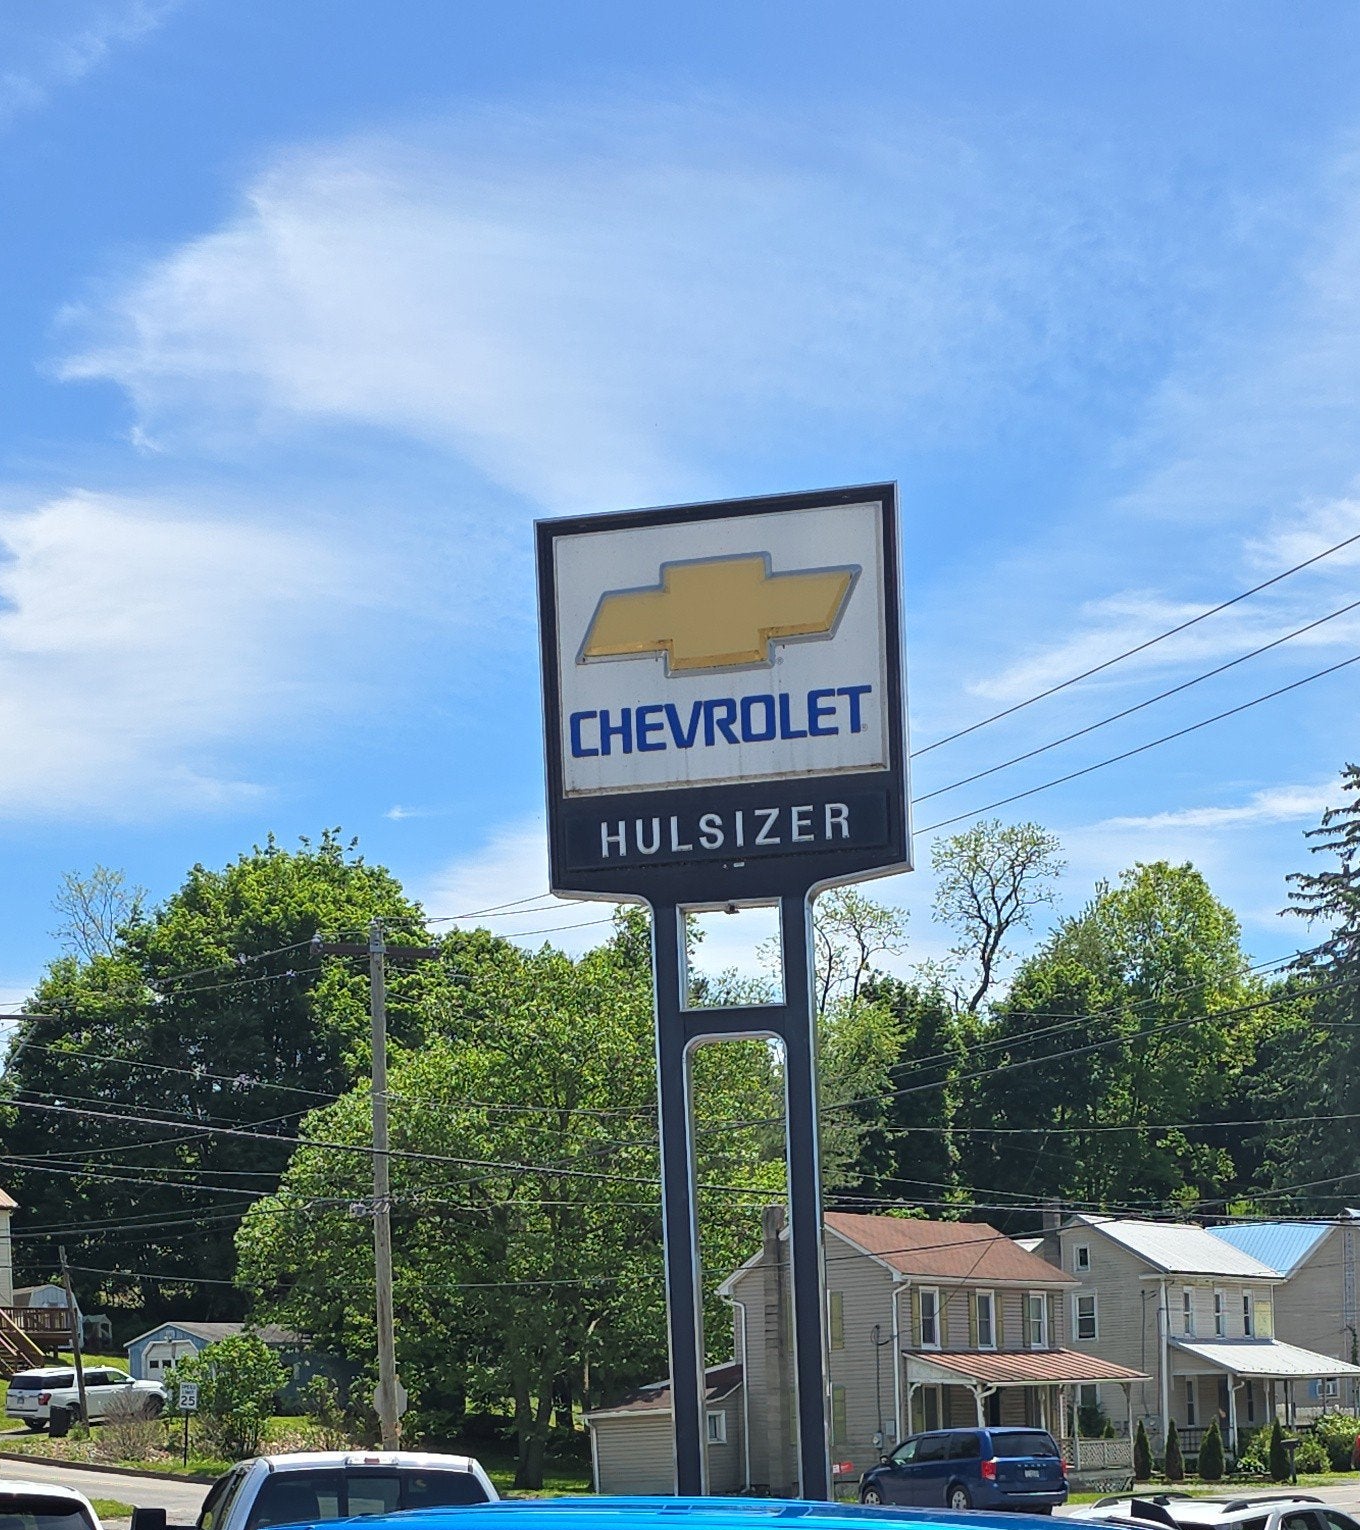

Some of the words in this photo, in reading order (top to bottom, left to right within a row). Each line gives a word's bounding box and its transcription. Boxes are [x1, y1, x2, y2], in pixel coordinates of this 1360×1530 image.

[569, 684, 872, 758] CHEVROLET
[600, 802, 850, 858] HULSIZER
[181, 1395, 196, 1406] 25
